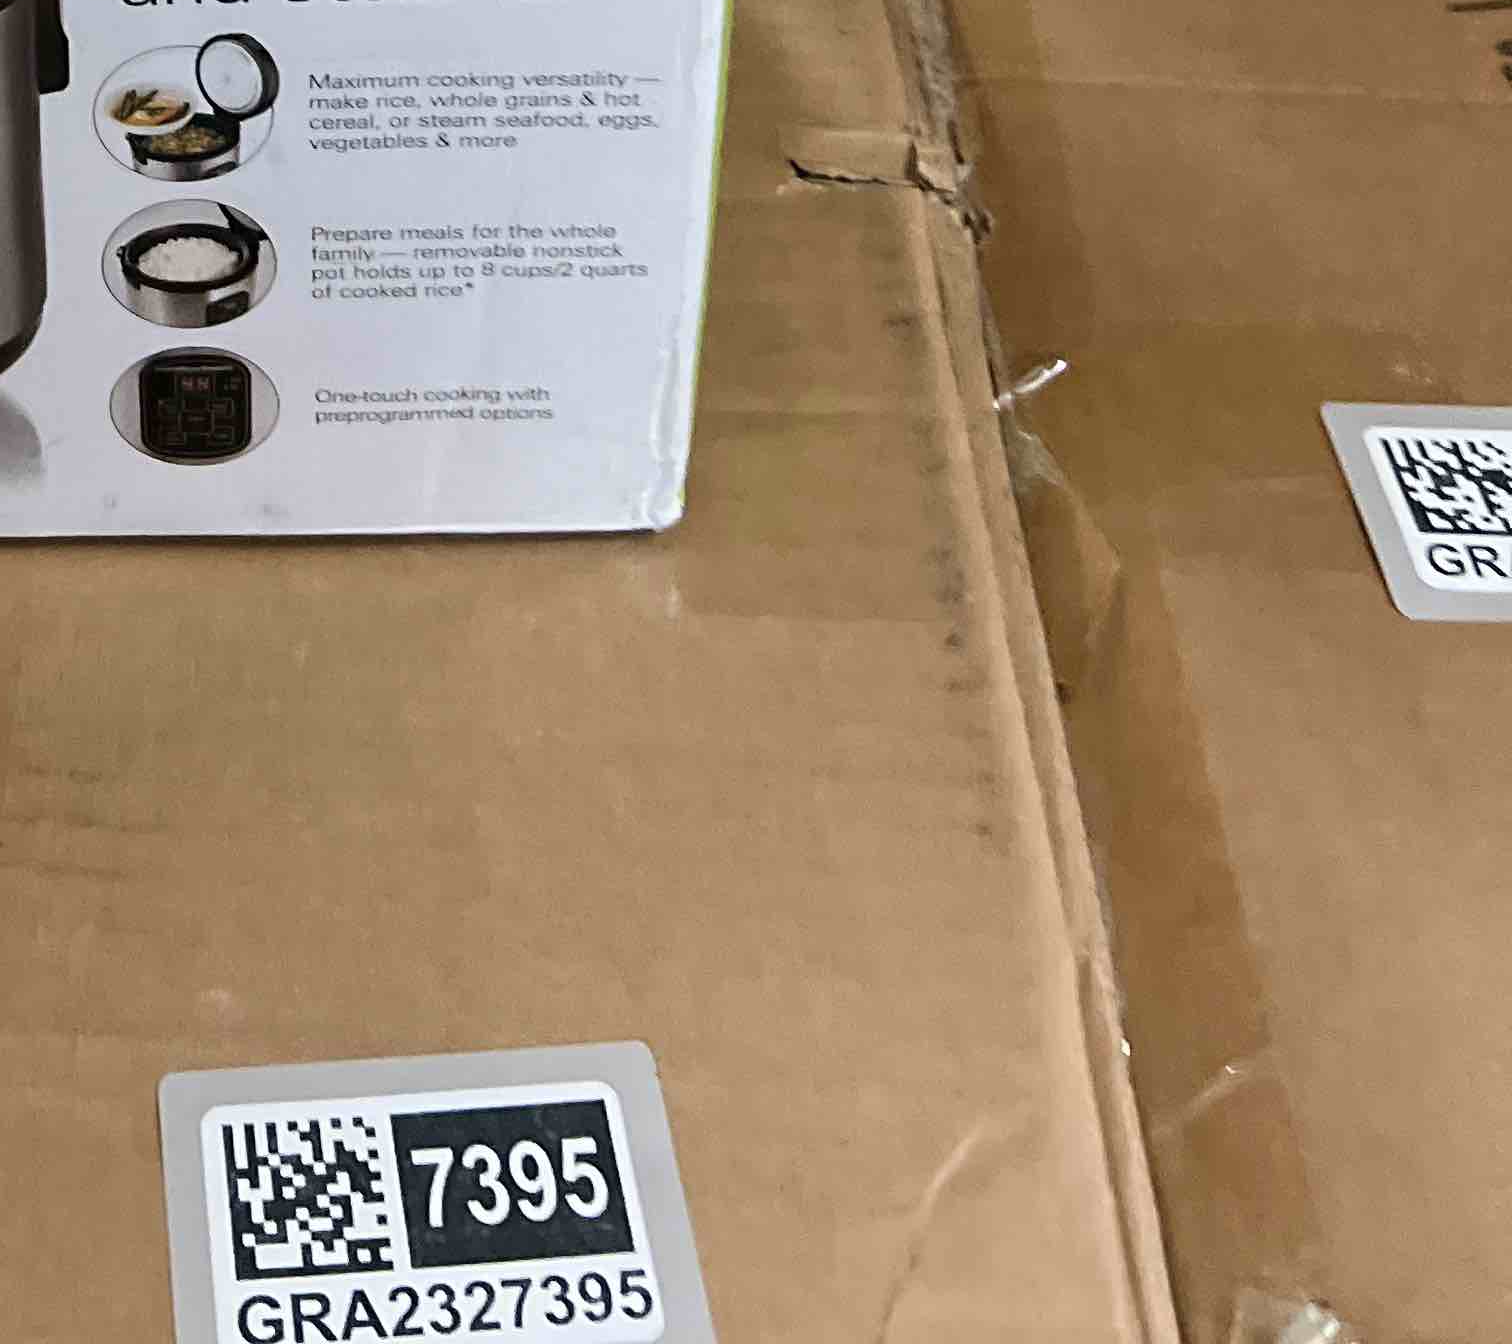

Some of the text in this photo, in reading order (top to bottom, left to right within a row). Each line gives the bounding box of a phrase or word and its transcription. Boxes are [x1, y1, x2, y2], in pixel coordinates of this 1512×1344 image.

[308, 74, 419, 89] Maximum
[426, 72, 514, 89] cooking
[523, 71, 627, 87] versatility
[308, 91, 641, 110] make rice, whole grains & hot
[308, 114, 381, 132] cereal,
[389, 116, 409, 129] or
[416, 114, 487, 128] steam
[495, 112, 590, 128] seafood,
[308, 132, 518, 152] vegetables & more
[311, 223, 616, 243] Prepare meals for the whole
[311, 246, 374, 263] family
[413, 245, 526, 259] removable
[532, 243, 624, 258] nonstick
[311, 263, 648, 281] pot holds up to 8 cups/2 quarts
[311, 284, 332, 299] of
[338, 283, 417, 299] cooked
[315, 387, 550, 403] One-touch cooking with
[315, 407, 553, 424] preprogrammed options
[410, 1137, 610, 1229] 7395
[237, 1269, 653, 1344] GRA2327395
